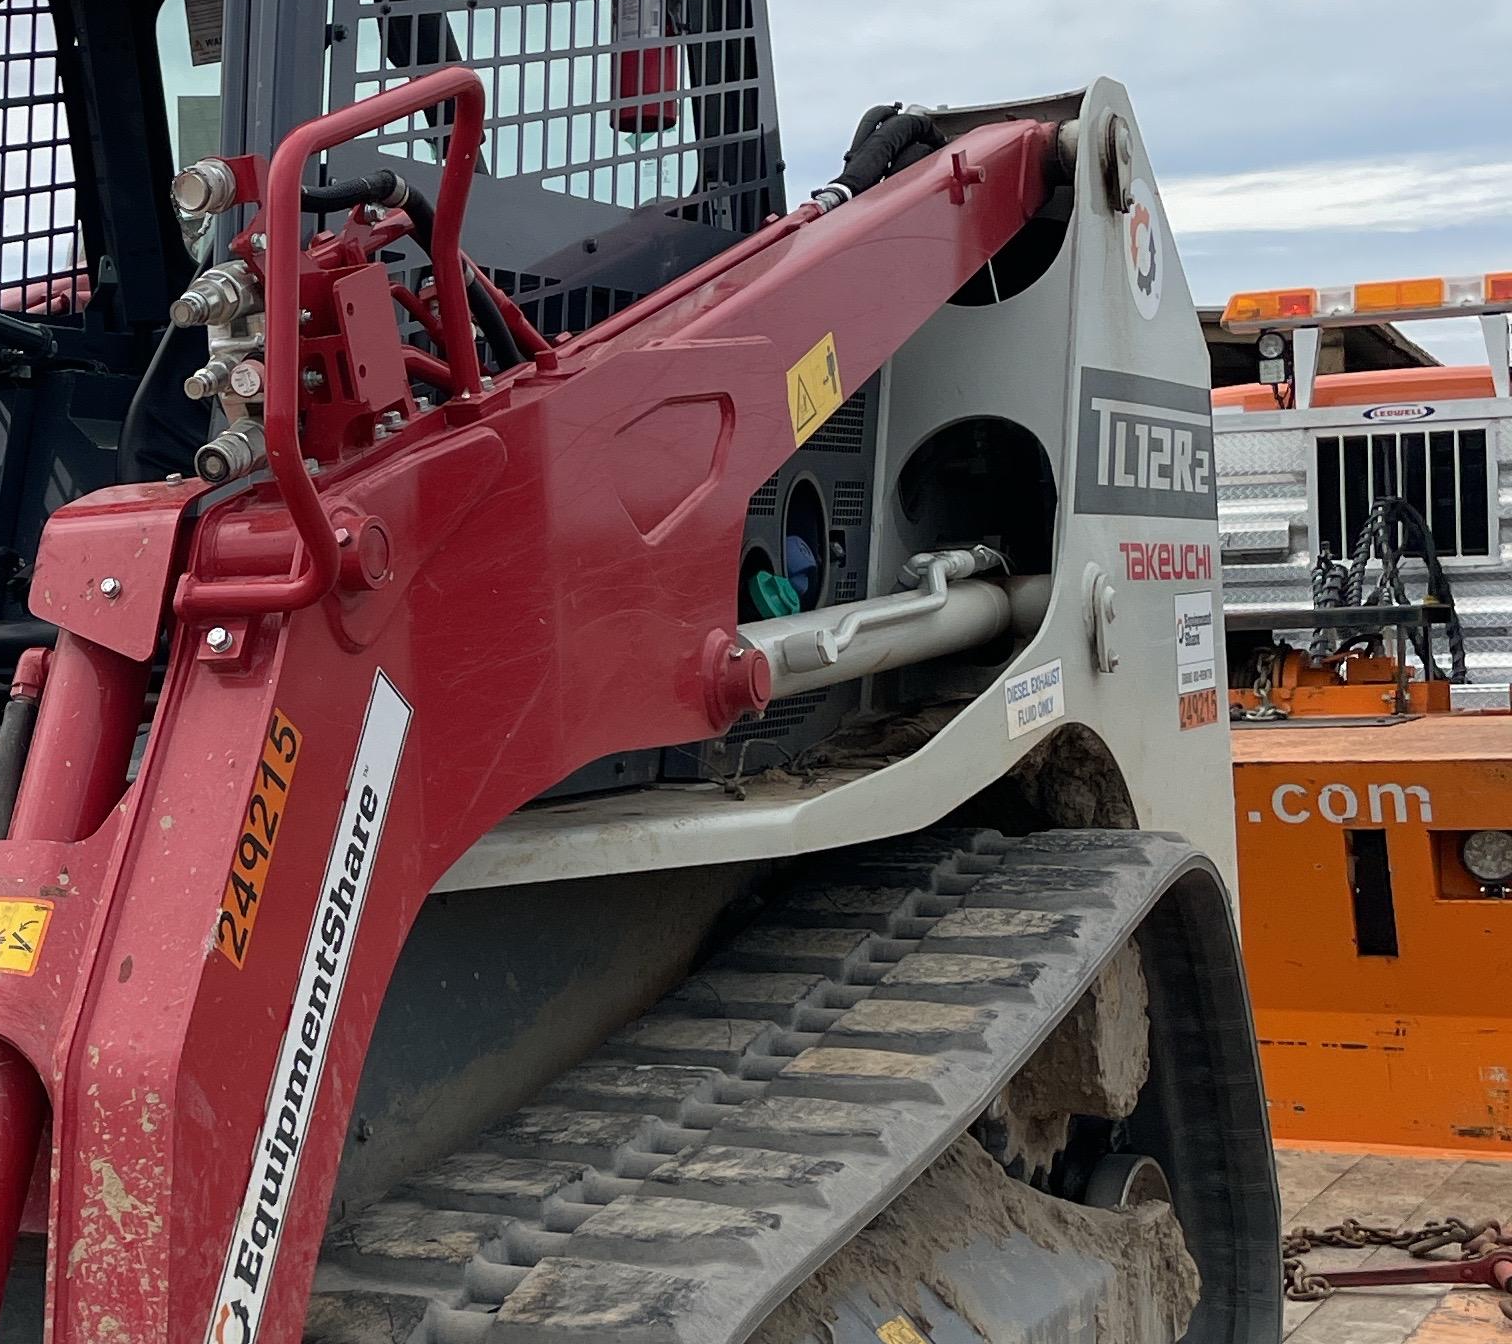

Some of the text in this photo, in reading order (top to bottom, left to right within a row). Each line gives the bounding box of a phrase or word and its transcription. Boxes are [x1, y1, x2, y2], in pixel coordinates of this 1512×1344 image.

[1091, 397, 1211, 494] TL12R2
[1119, 543, 1212, 581] TAKEUCHI
[1007, 666, 1060, 705] DIESEL EXHAUST
[1018, 696, 1054, 728] FLUID ONLY
[1180, 690, 1217, 730] 249215
[1248, 783, 1432, 823] .com
[218, 714, 298, 964] 249215
[234, 784, 379, 1293] EquipmentShare
